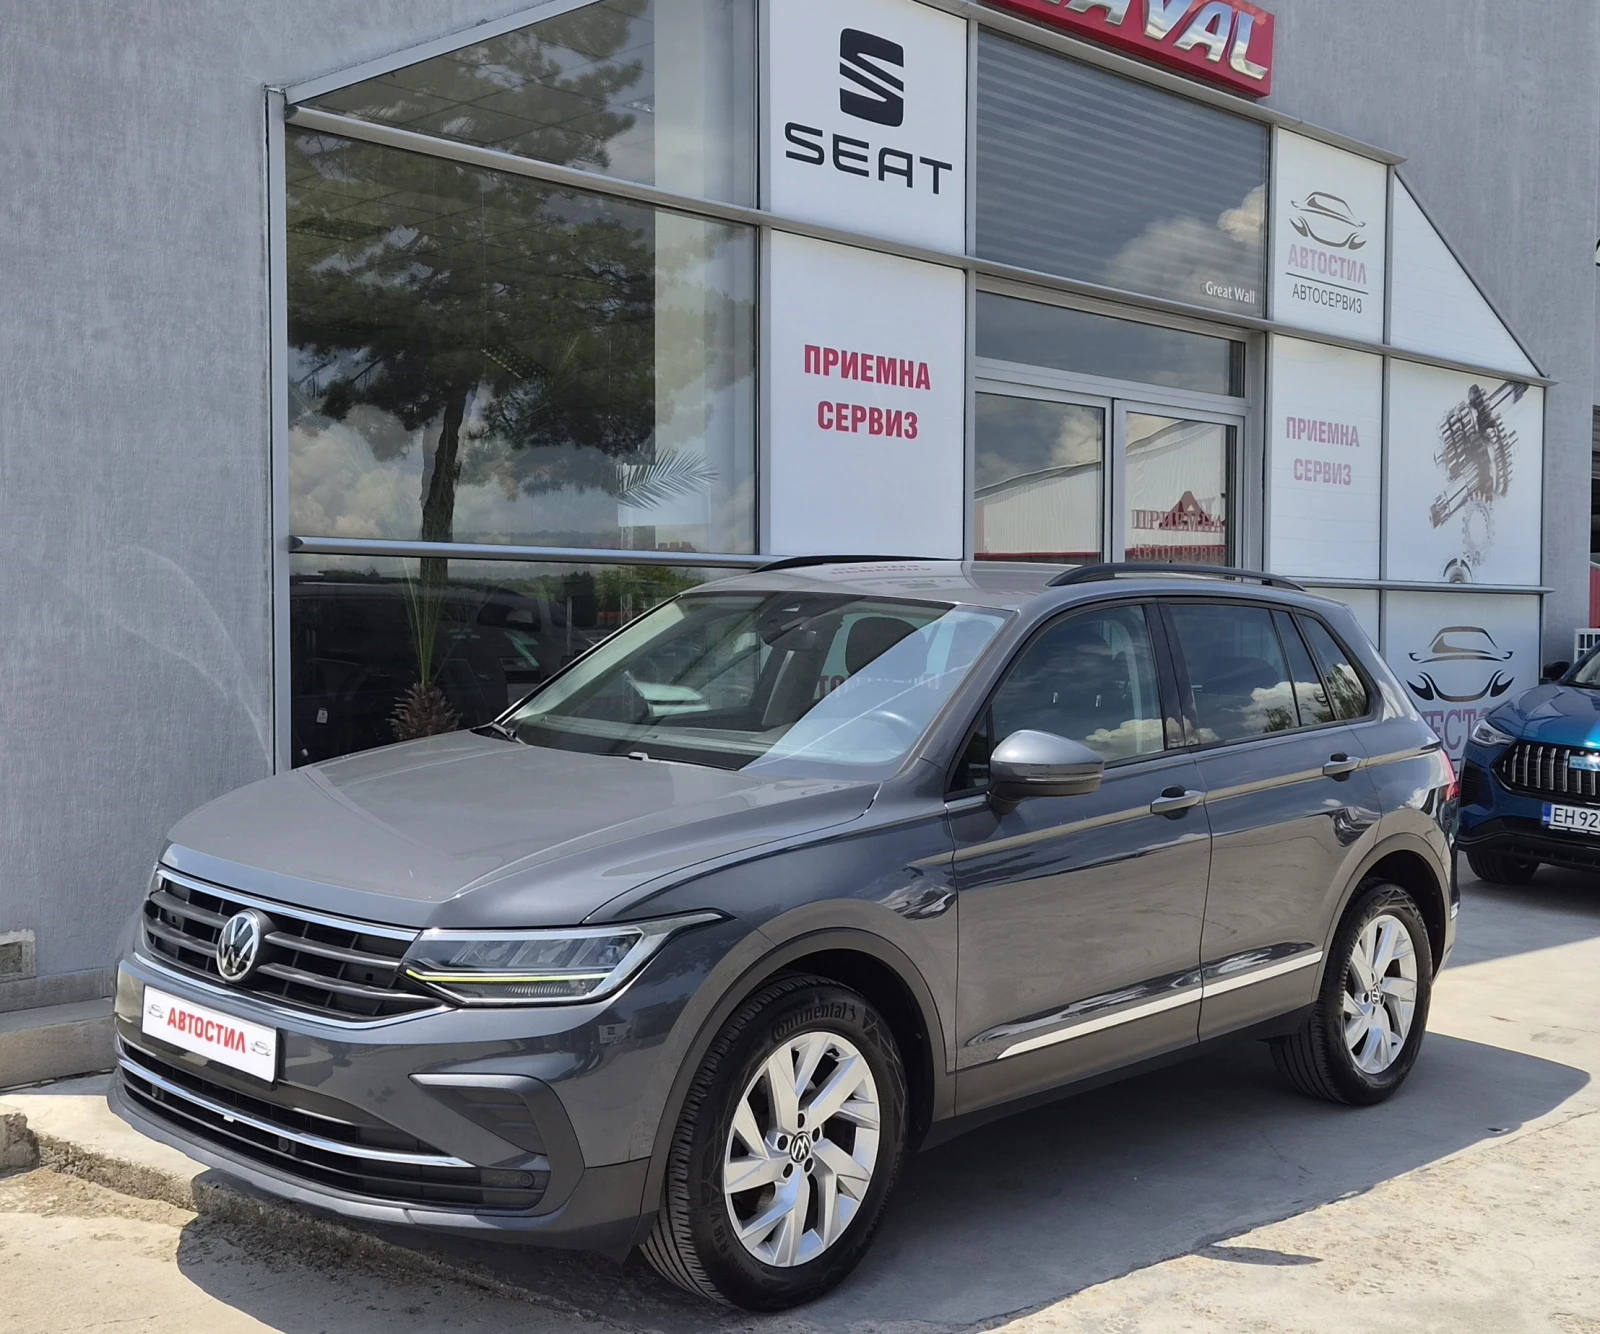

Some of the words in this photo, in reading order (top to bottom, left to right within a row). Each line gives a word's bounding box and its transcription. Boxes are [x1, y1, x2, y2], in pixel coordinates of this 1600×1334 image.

[1046, 0, 1269, 80] VAL
[785, 122, 952, 195] SEAT
[1288, 243, 1367, 285] АВТОСТИЛ
[1205, 281, 1232, 299] Great
[1234, 287, 1255, 304] Wall
[1292, 283, 1362, 314] АВТОСЕРВИЗ
[804, 344, 931, 391] ПРИЕМНА
[817, 400, 918, 440] СЕРВИЗ
[1286, 416, 1360, 447] ПРИЕМНА
[1293, 458, 1352, 486] СЕРВИЗ
[1131, 509, 1225, 533] ПРИЕМНА
[1131, 544, 1225, 562] АВТОСЕРВИЗ
[1554, 807, 1576, 825] EH
[1579, 811, 1600, 829] 92
[167, 1007, 247, 1054] АВТОСТИЛ
[771, 1002, 847, 1042] Continental
